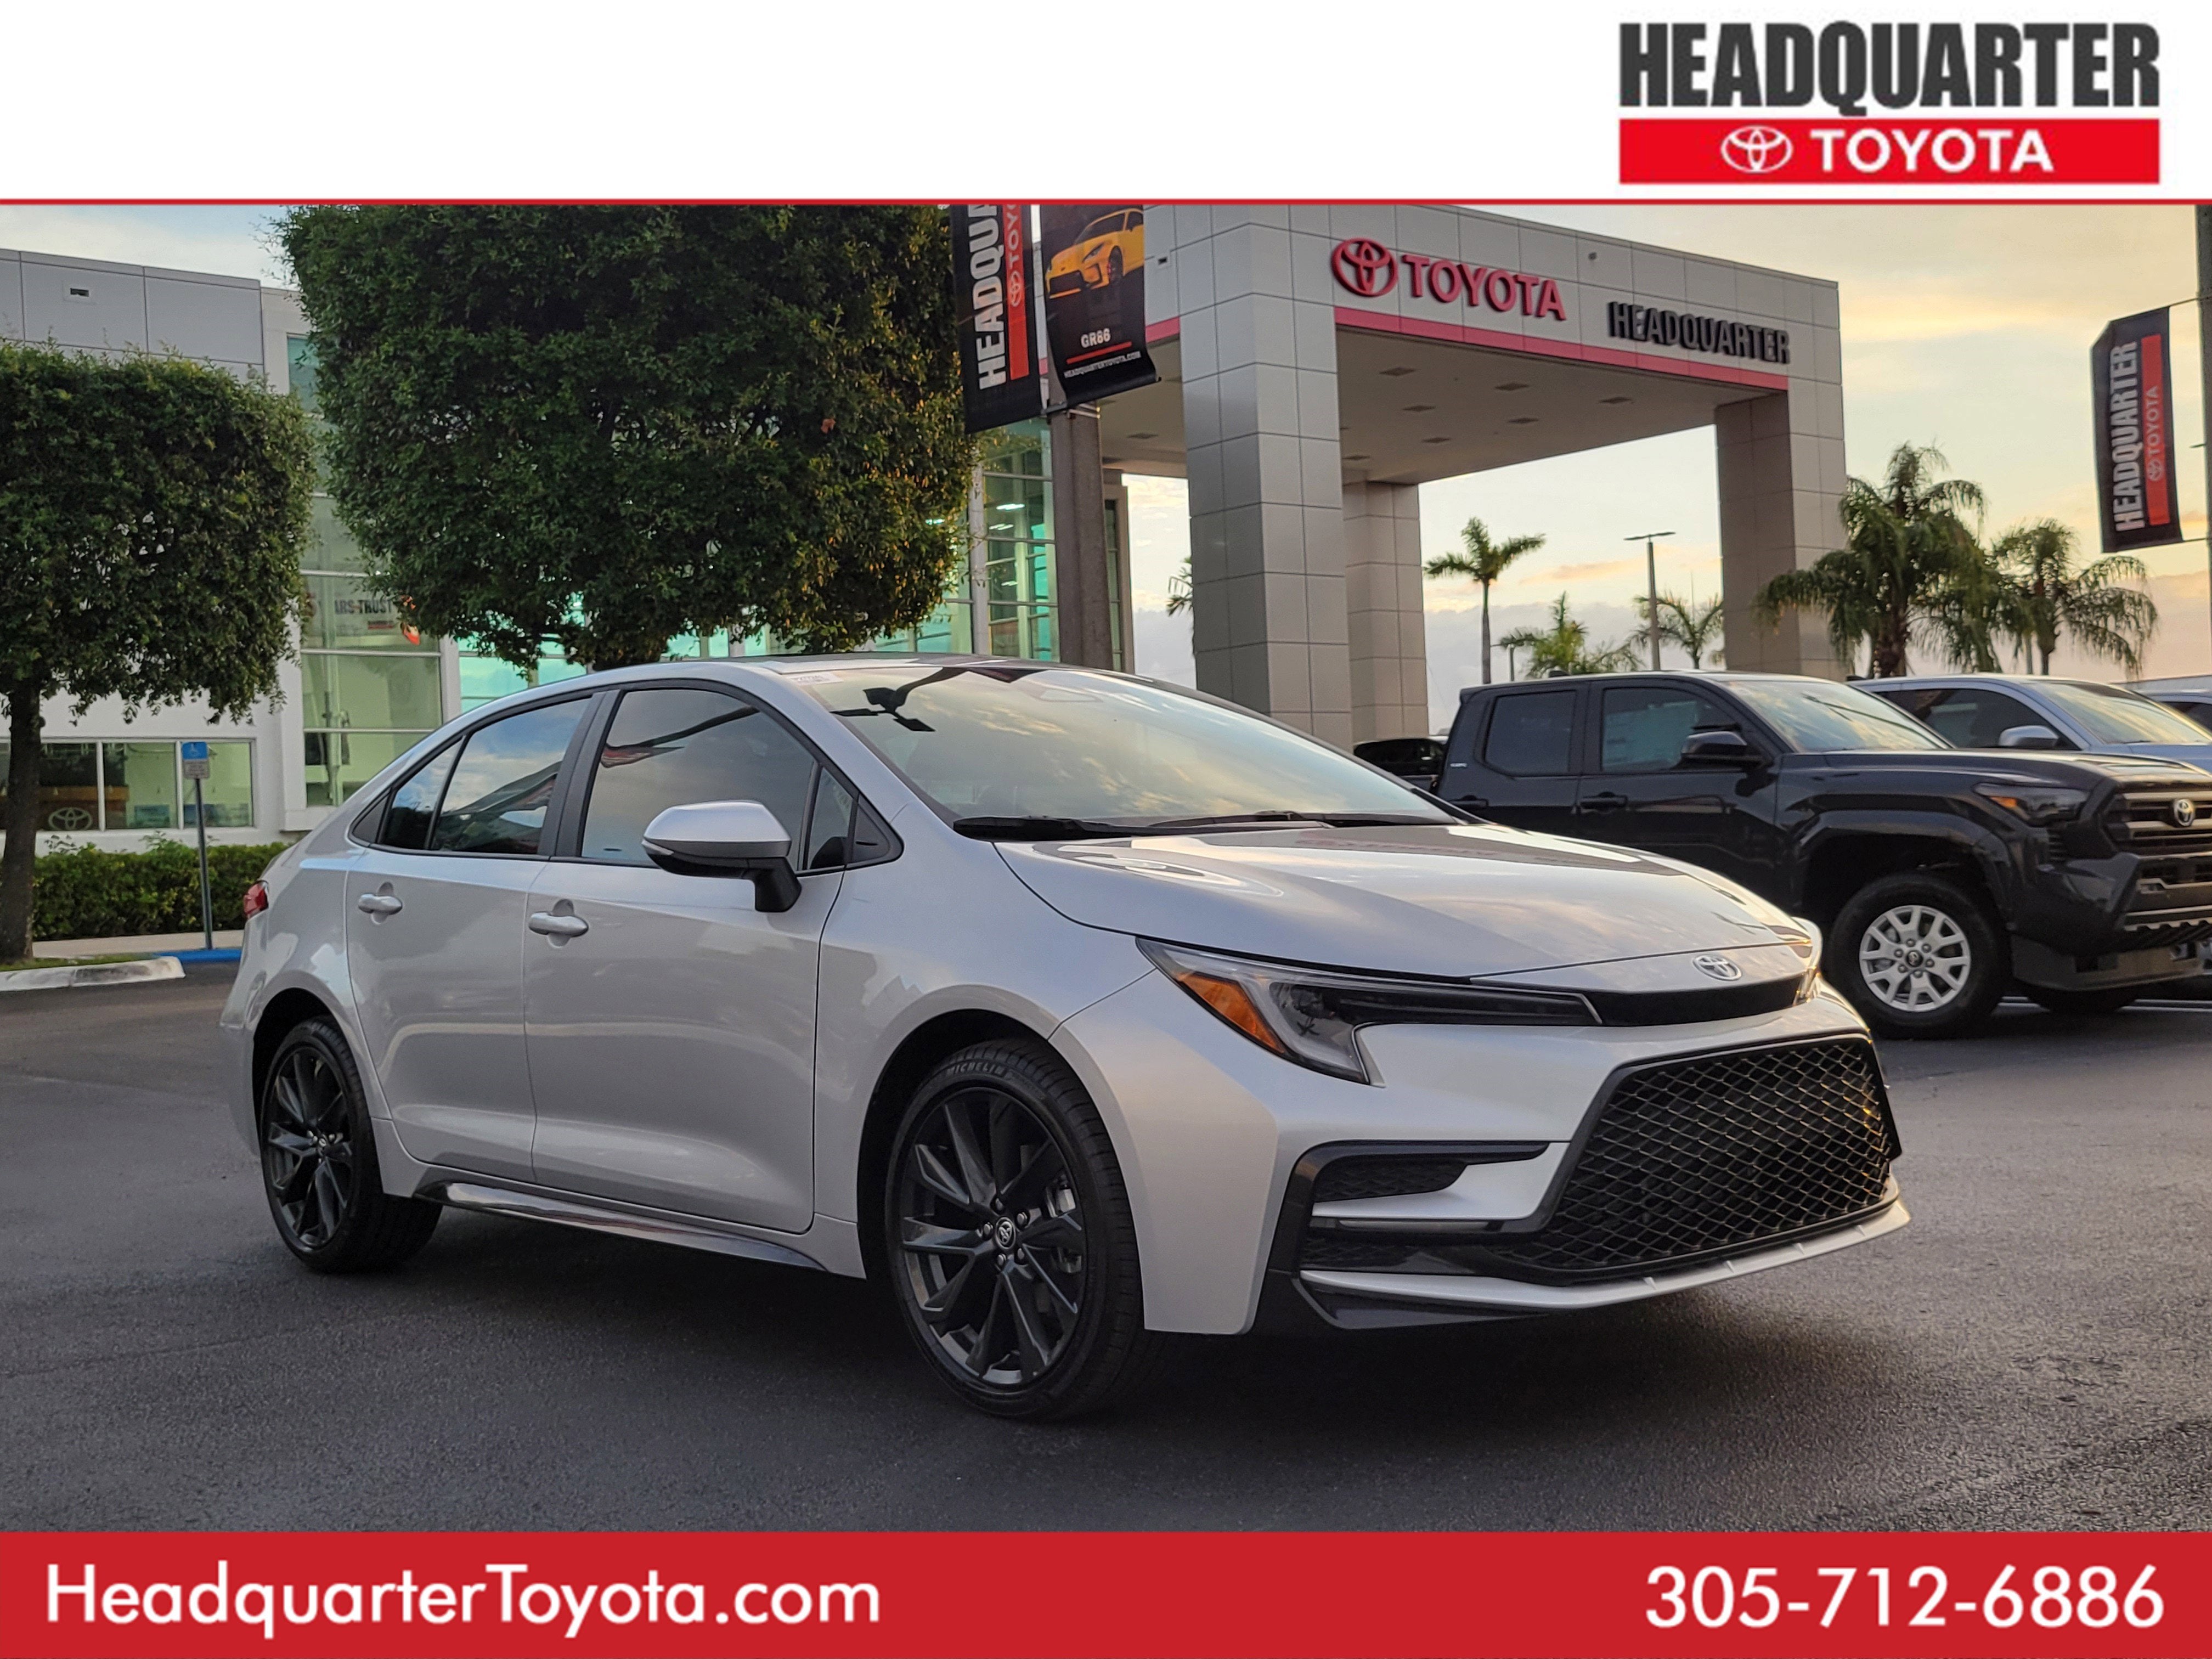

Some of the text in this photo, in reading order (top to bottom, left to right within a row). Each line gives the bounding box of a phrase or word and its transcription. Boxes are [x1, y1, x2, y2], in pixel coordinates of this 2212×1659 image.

[1007, 205, 1020, 269] TOY
[1402, 255, 1566, 321] TOYOTA
[1609, 302, 1790, 364] HEADQUARTER
[2109, 341, 2145, 532] HEADQUARTER
[2146, 385, 2159, 456] TOYOTA
[946, 1062, 1005, 1076] MICHELIN
